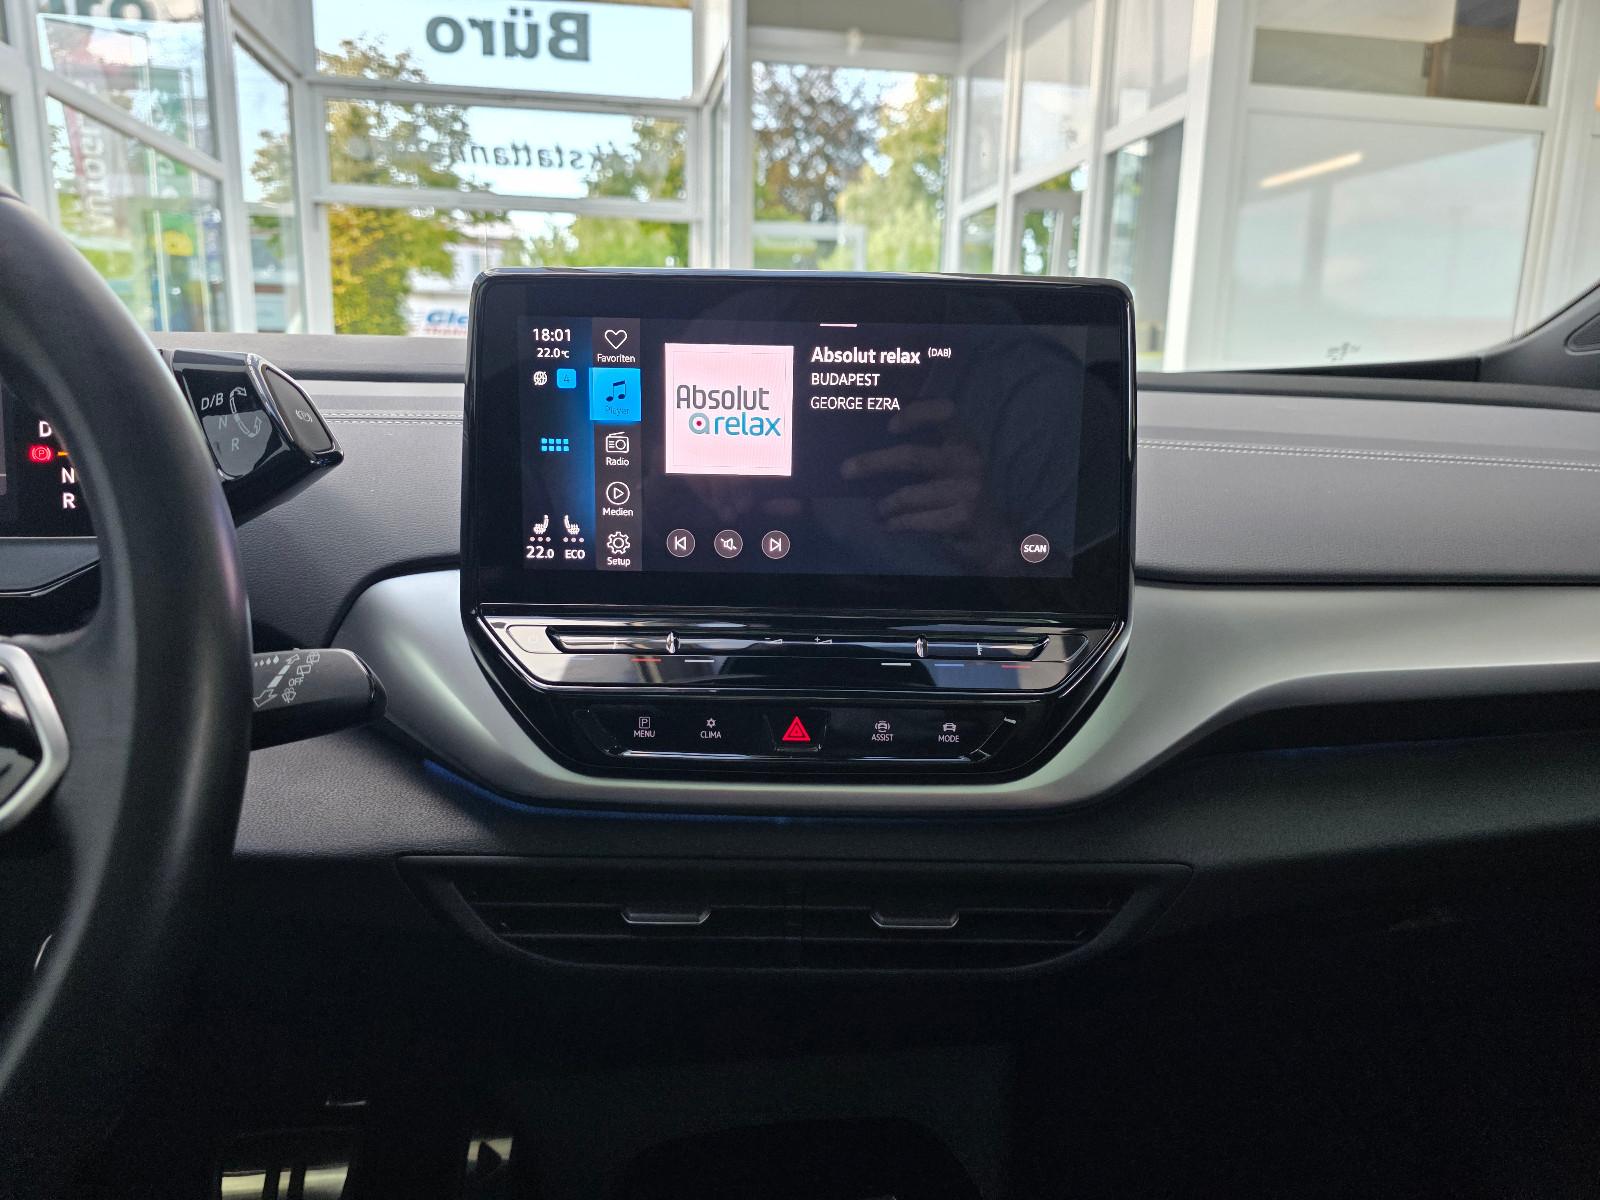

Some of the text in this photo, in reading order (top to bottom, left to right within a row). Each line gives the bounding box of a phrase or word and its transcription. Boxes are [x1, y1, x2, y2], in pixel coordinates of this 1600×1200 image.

[532, 328, 572, 342] 18:01
[596, 353, 636, 364] Favoriten
[810, 346, 952, 365] Absolut relax (DAB)
[810, 372, 881, 387] BUDAPEST
[200, 392, 224, 411] D/B
[676, 384, 770, 411] Absolut
[810, 396, 901, 411] GEORGE EZRA
[38, 420, 53, 438] D
[714, 411, 782, 437] relax
[231, 437, 240, 452] R
[605, 456, 630, 467] Radio
[61, 467, 76, 484] N
[62, 492, 77, 509] R
[602, 507, 634, 518] Medien
[525, 545, 586, 560] 22.0 ECO
[1023, 544, 1048, 553] SCAN
[606, 556, 631, 568] Setup
[288, 676, 305, 687] OFF
[633, 729, 656, 738] MENU
[700, 730, 722, 739] CLIMA
[871, 733, 894, 742] ASSIST
[938, 734, 960, 743] MODE
